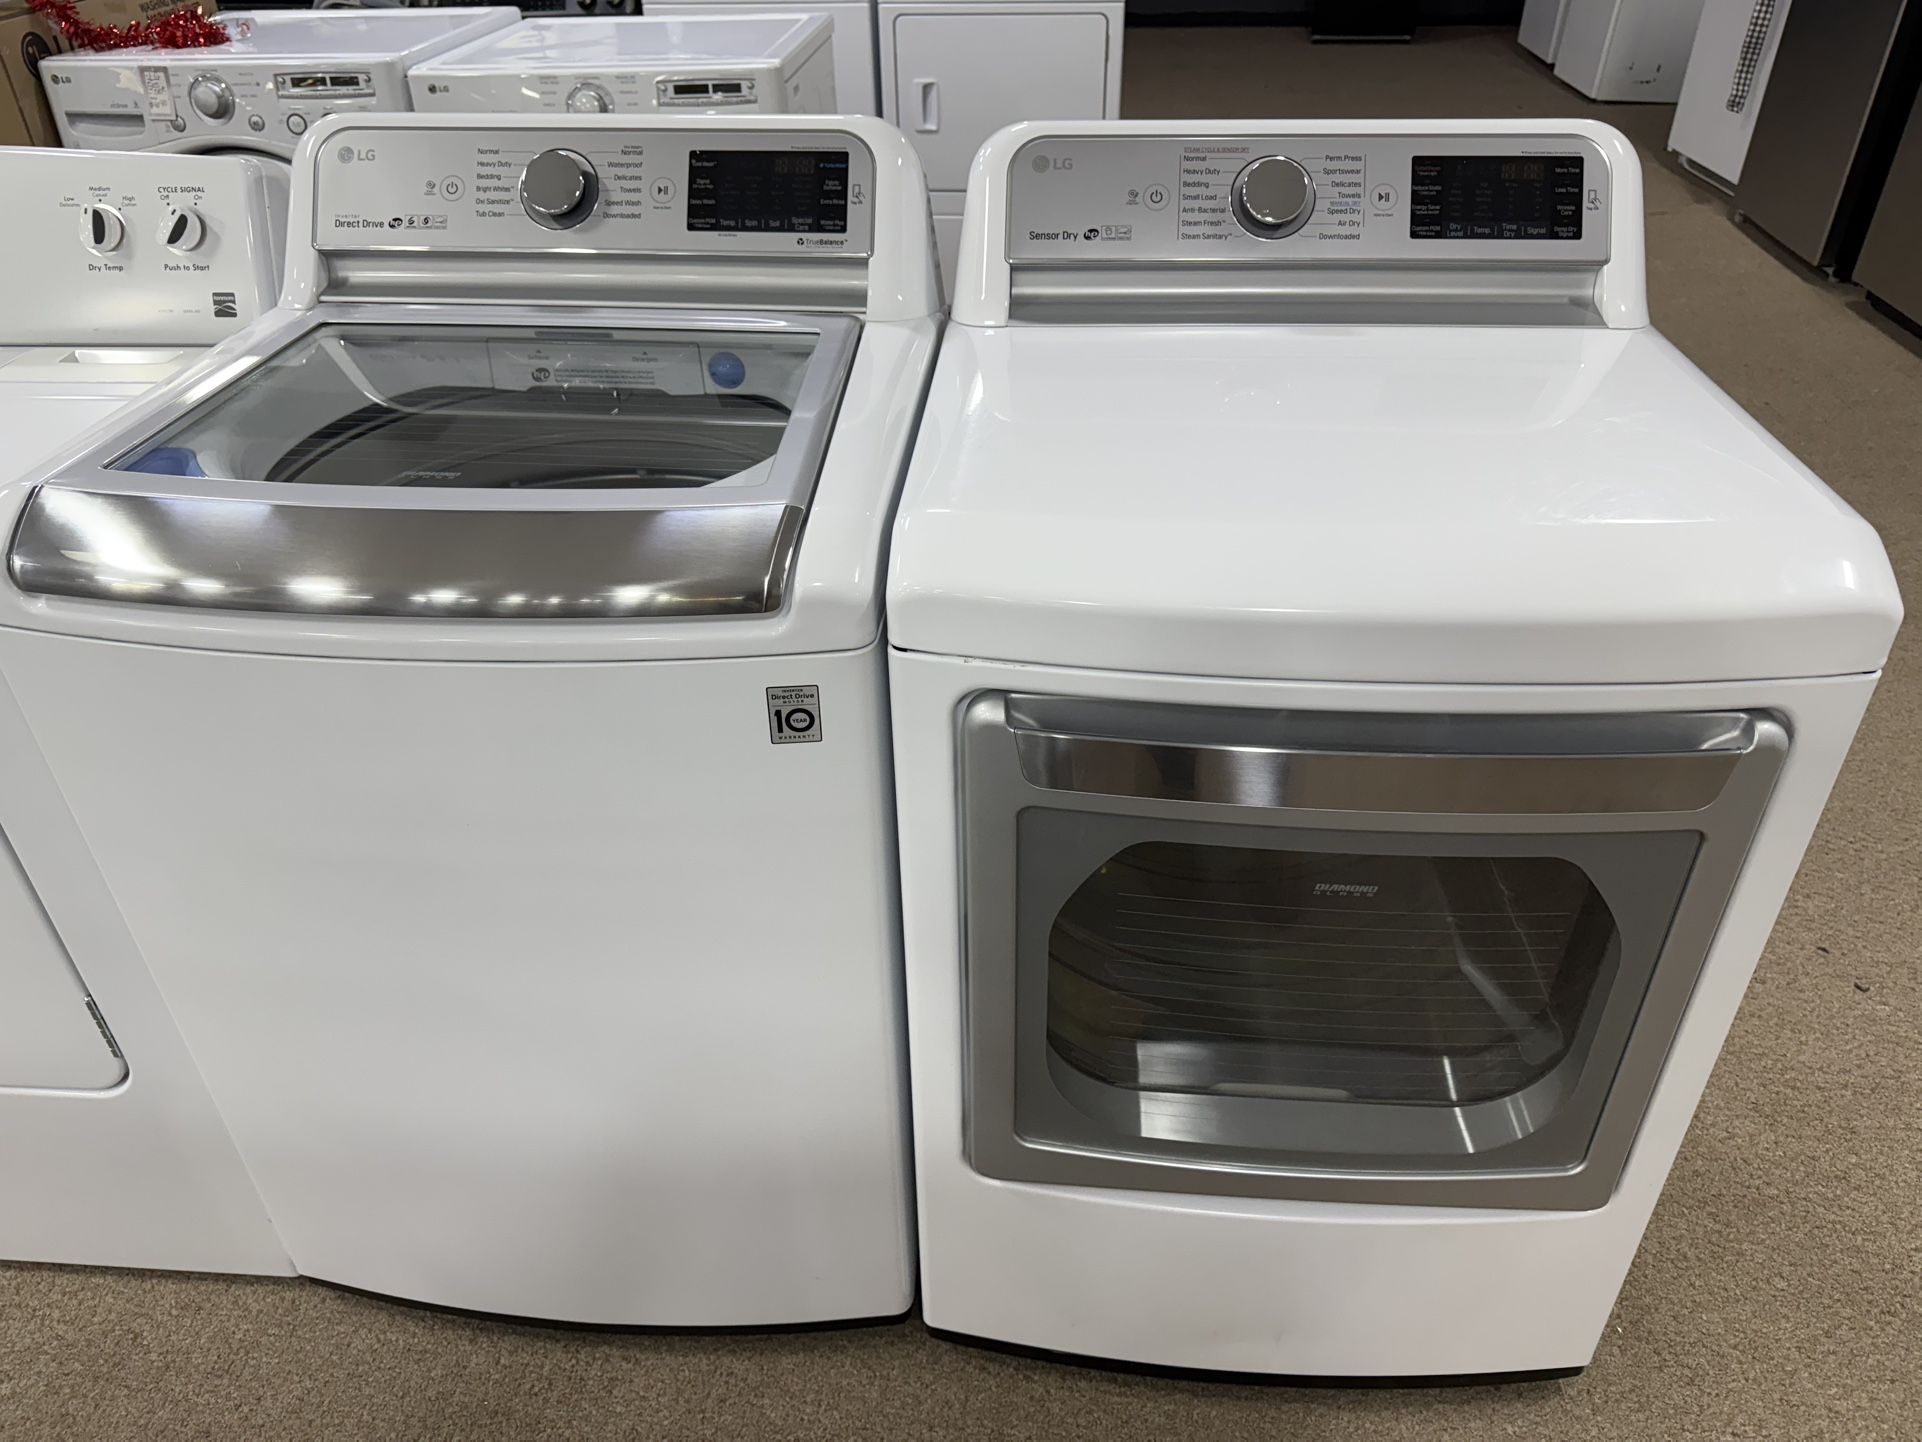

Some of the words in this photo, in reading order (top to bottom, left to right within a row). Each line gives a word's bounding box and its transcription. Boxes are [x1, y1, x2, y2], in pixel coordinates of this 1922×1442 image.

[61, 76, 72, 84] LG
[438, 85, 449, 93] LG
[357, 148, 376, 161] LG
[477, 148, 500, 156] Normal
[621, 148, 644, 156] Normal
[1183, 154, 1207, 162] Normal
[477, 161, 496, 169] Heavy
[497, 161, 512, 169] Duty
[607, 161, 643, 169] Waterproof
[1053, 158, 1073, 170] LG
[1182, 168, 1202, 176] Heavy
[1204, 168, 1220, 176] Duty
[1322, 168, 1362, 176] Sportswear
[476, 173, 502, 182] Bedding
[614, 174, 643, 182] Delicates
[1182, 180, 1210, 189] Bedding
[1331, 180, 1362, 188] Delicates
[476, 186, 491, 194] Bright
[619, 186, 642, 194] Towels
[1182, 193, 1200, 201] Small
[1200, 193, 1217, 201] Load
[604, 199, 623, 208] Speed
[475, 210, 487, 218] Tub
[488, 210, 505, 218] Clean
[1182, 206, 1226, 214] Anti-Bacterial
[1327, 207, 1346, 216] Speed
[1348, 207, 1361, 216] Dry
[602, 212, 642, 220] Downloaded
[334, 219, 361, 228] Direct
[362, 220, 385, 228] Drive
[792, 217, 812, 225] Special
[1348, 220, 1360, 228] Dry
[1504, 230, 1516, 238] Dry
[1528, 226, 1546, 235] Signal
[1028, 230, 1060, 241] Sensor
[1062, 231, 1078, 242] Dry
[1181, 232, 1200, 240] Steam
[1319, 232, 1360, 240] Downloaded
[88, 264, 102, 272] Dry
[104, 264, 124, 272] Temp
[774, 708, 816, 734] 10
[1314, 883, 1379, 893] DIAMOND
